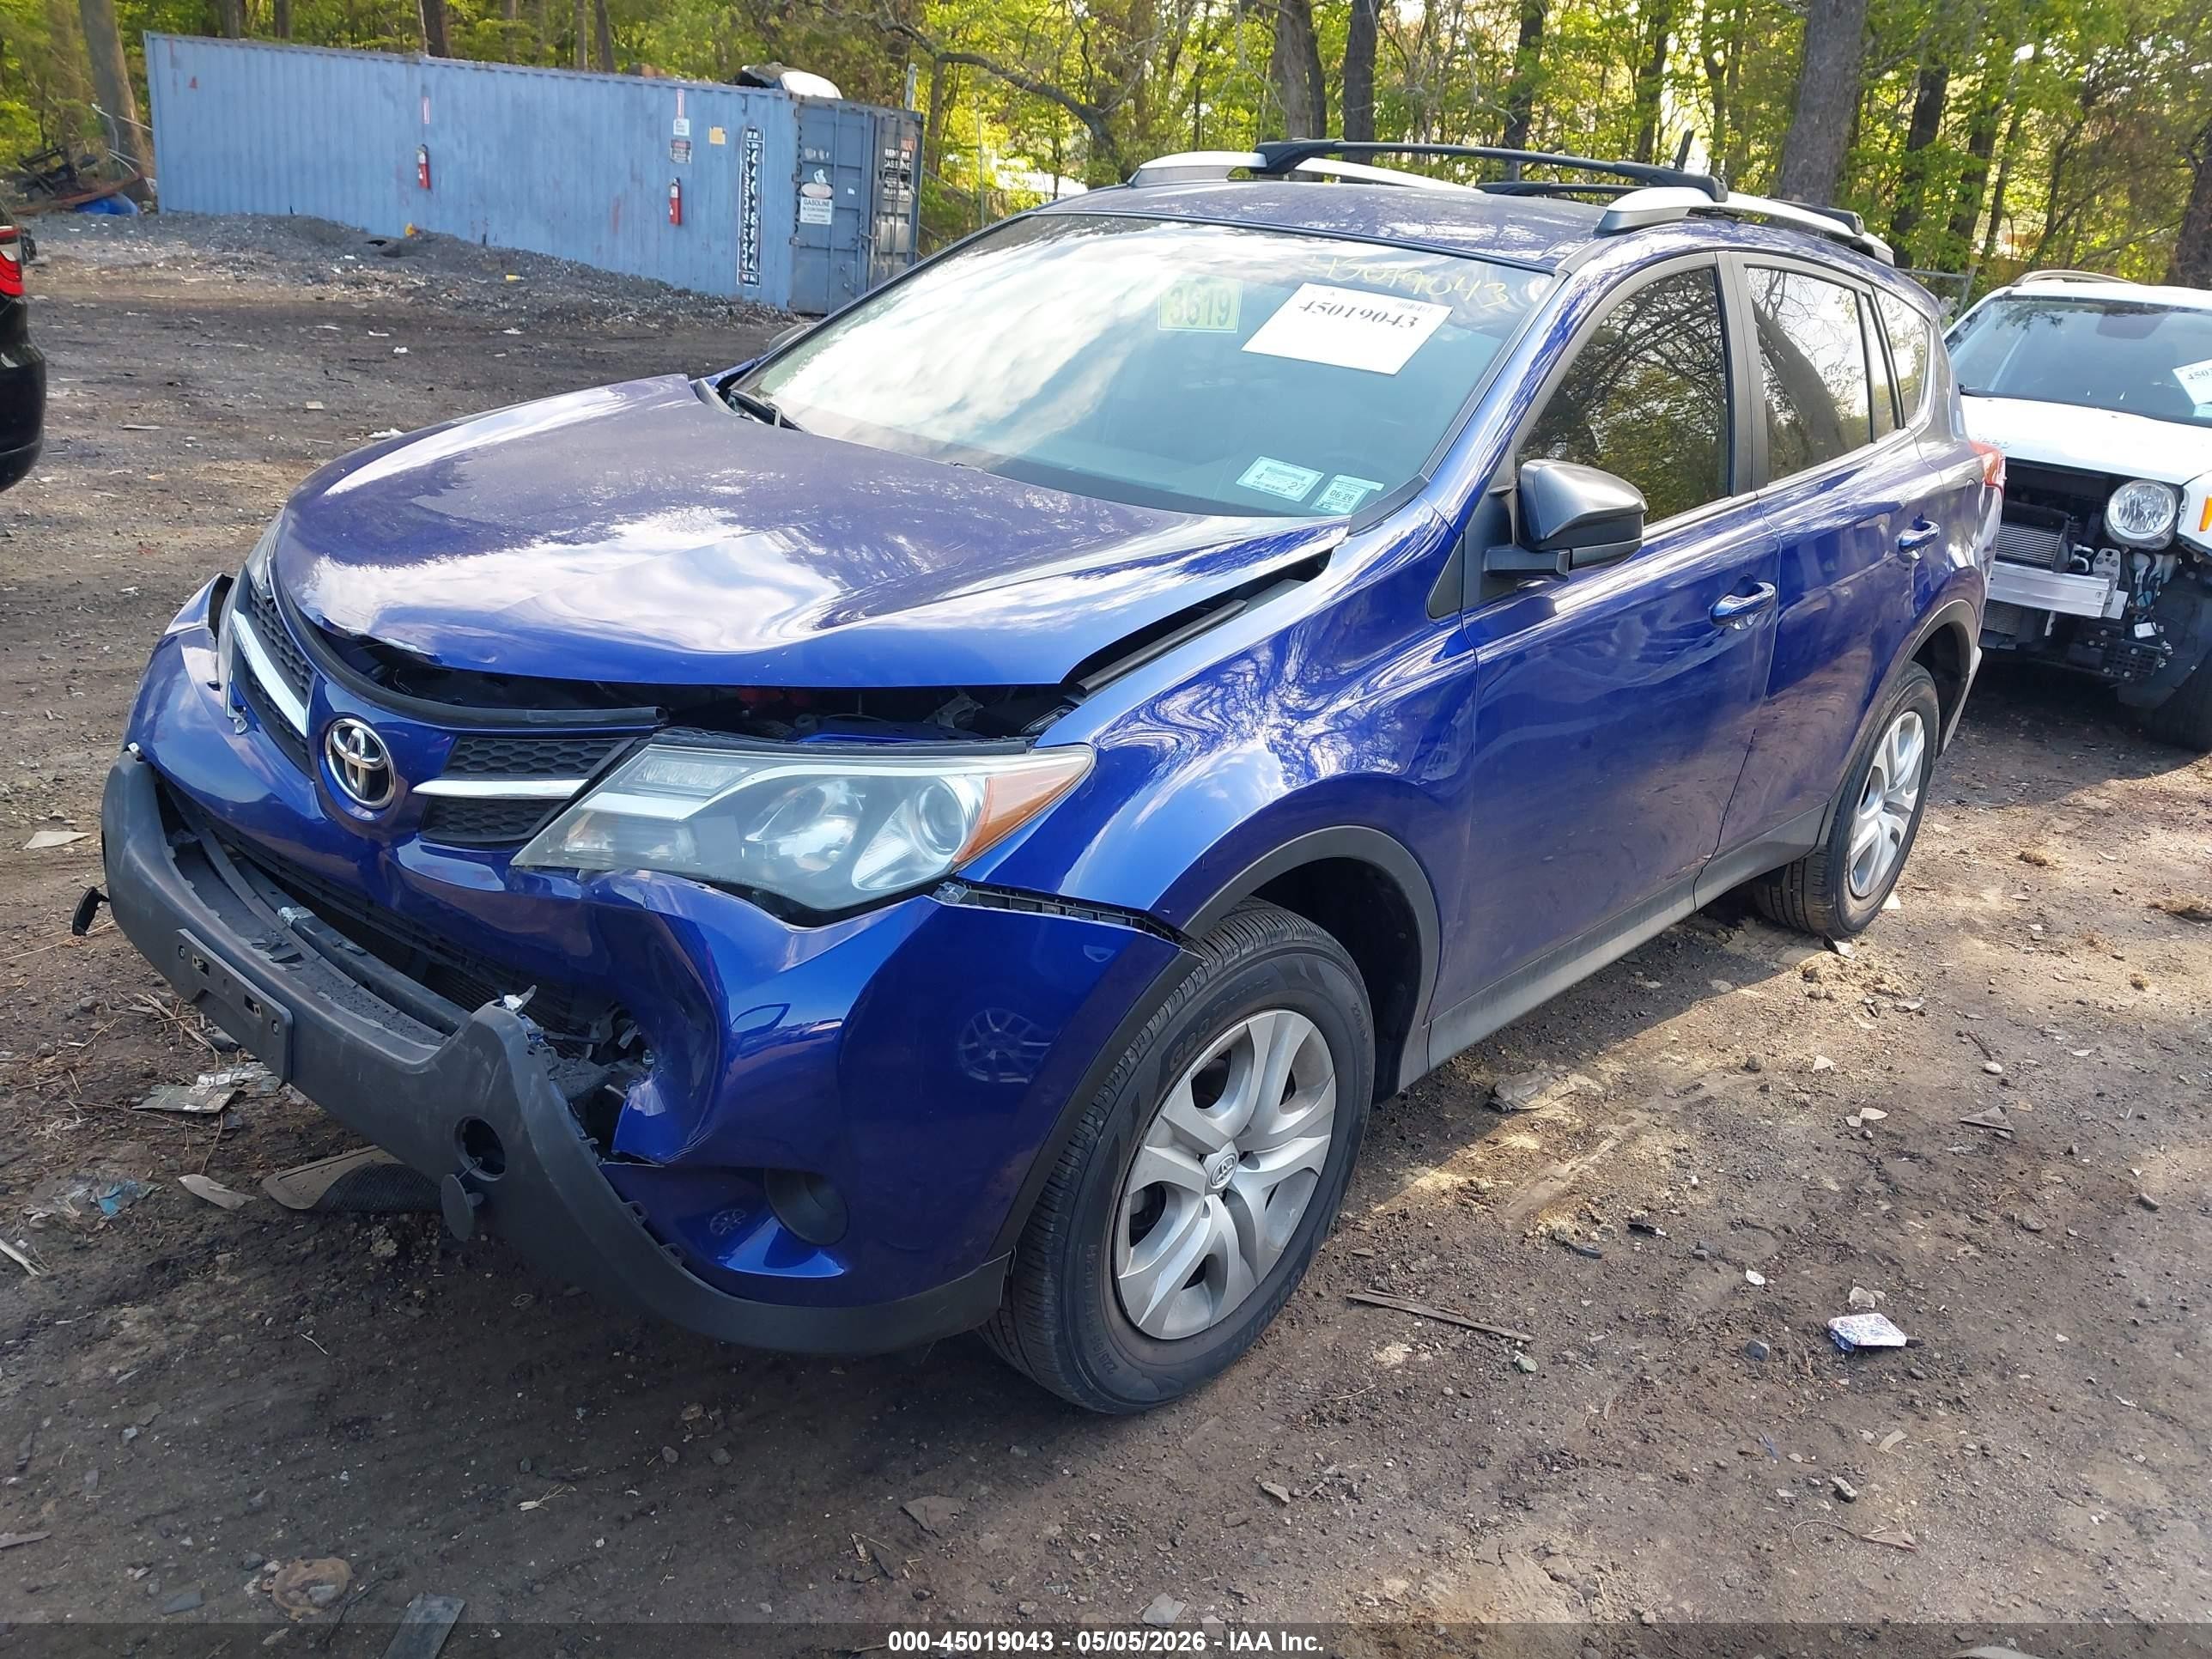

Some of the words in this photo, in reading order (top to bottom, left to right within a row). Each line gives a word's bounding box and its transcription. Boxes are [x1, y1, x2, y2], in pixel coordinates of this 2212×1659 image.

[1170, 287, 1231, 326] 3619
[1298, 301, 1420, 329] 45019043
[1287, 481, 1306, 491] 27
